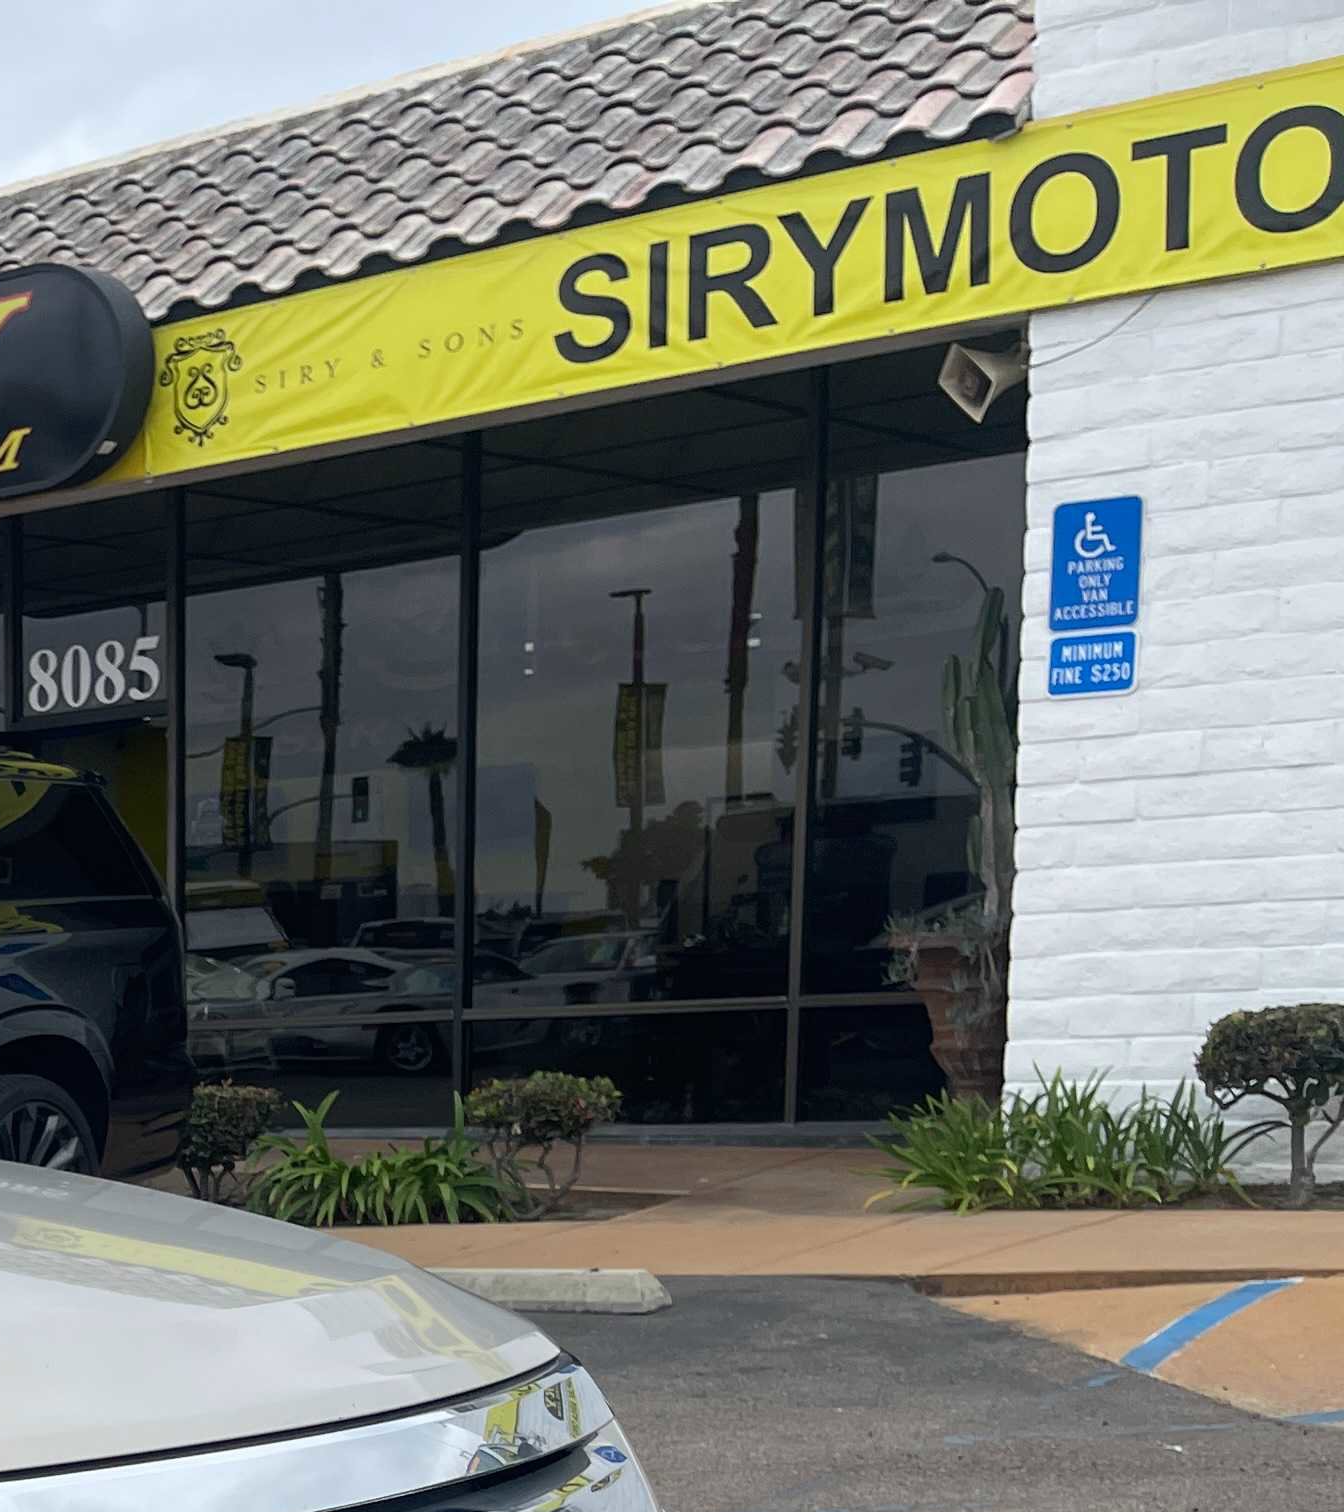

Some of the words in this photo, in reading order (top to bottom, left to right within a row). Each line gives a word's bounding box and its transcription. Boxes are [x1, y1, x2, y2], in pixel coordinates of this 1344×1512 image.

[552, 101, 1344, 364] SIRYMOTO
[254, 357, 341, 394] SIRY
[370, 348, 386, 369] &
[418, 318, 525, 360] SONS
[1067, 556, 1125, 575] PARKING
[1078, 573, 1112, 588] ONLY
[1081, 588, 1108, 603] VAN
[1053, 600, 1135, 621] ACCESSIBLE
[1061, 641, 1124, 662] MINIMUM
[28, 635, 161, 713] 8085
[1051, 666, 1083, 686] FINE
[1091, 662, 1131, 684] $250
